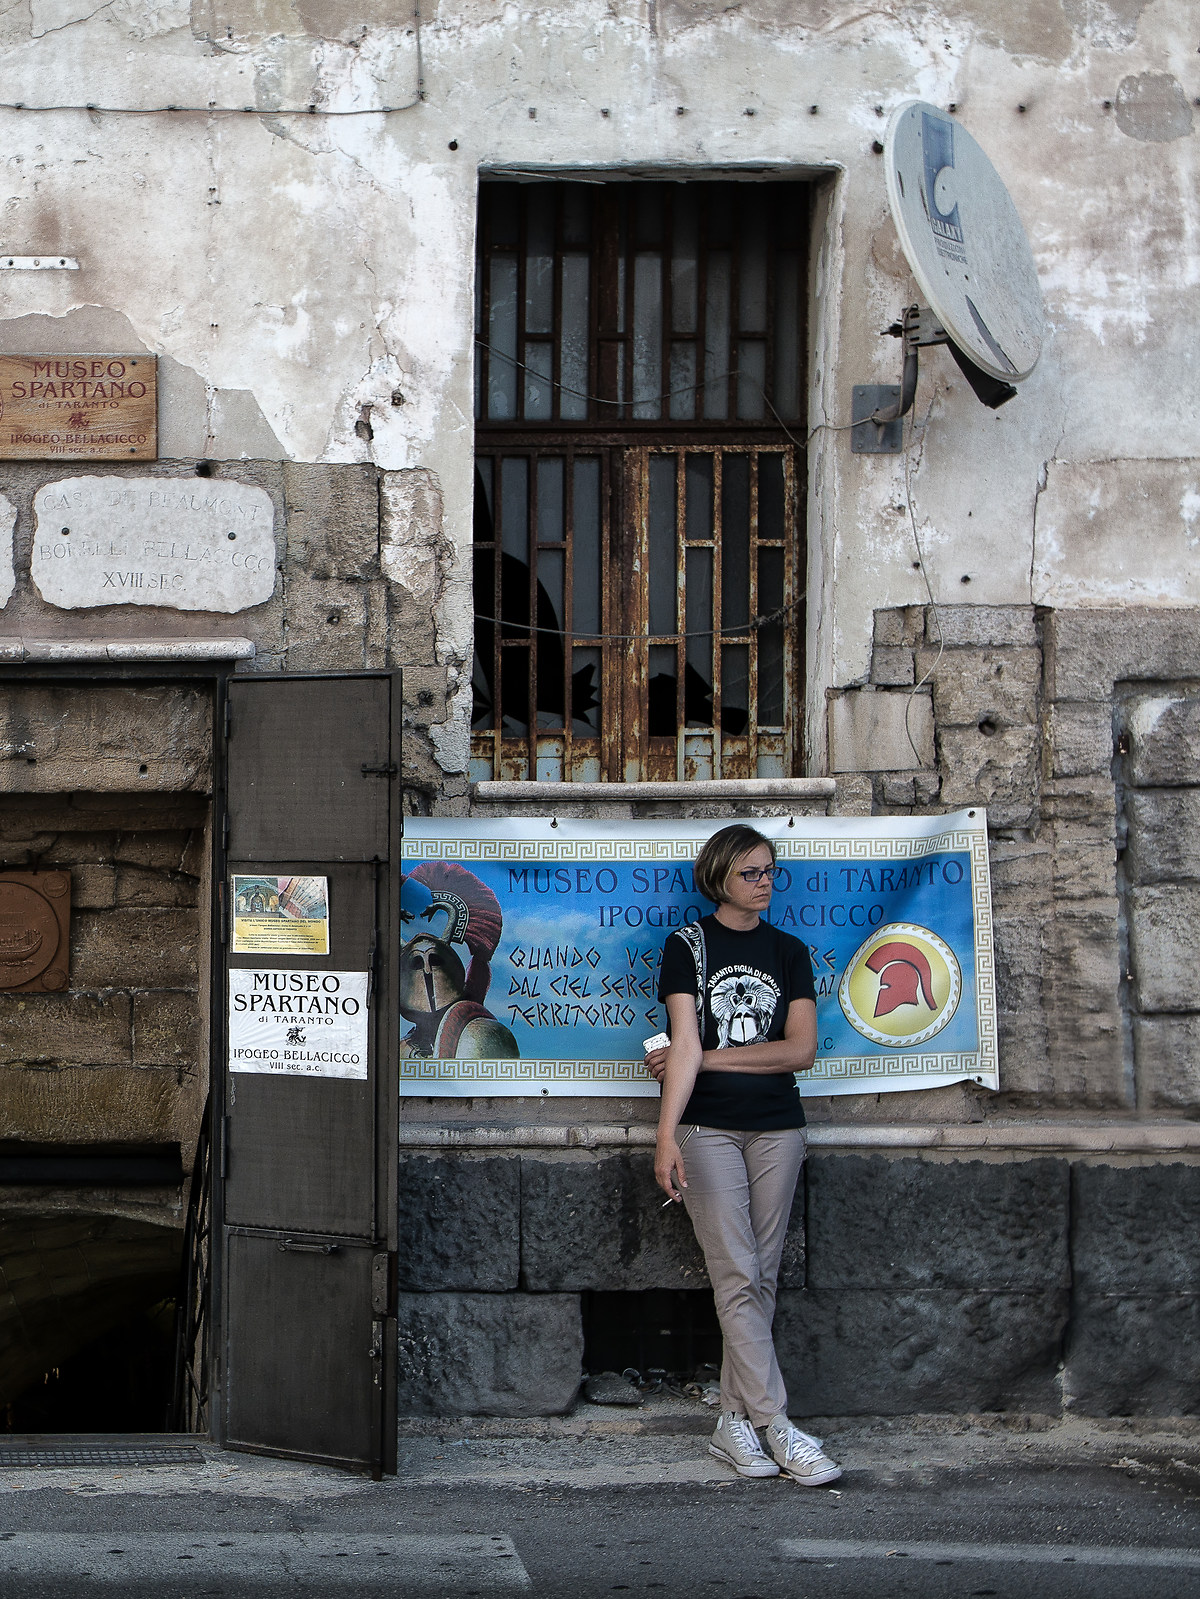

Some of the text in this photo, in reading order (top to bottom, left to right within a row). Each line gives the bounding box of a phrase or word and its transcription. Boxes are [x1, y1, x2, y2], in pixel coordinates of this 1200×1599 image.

[930, 217, 962, 241] GALAXY
[33, 360, 126, 379] MUSEO
[11, 381, 147, 399] SPARTANO
[38, 400, 120, 409] di TARANTO
[10, 434, 147, 444] IPOGEO BELLACICCO
[49, 446, 66, 454] VIII
[102, 571, 187, 591] XVIII SEC.
[508, 868, 618, 894] MUSEO
[806, 868, 829, 893] di
[839, 860, 964, 893] TARANTO
[599, 905, 702, 927] IPOGEO
[509, 946, 601, 970] QUANDO
[253, 973, 340, 993] MUSEO
[508, 976, 541, 998] DAL
[550, 975, 592, 999] CIEL
[708, 964, 781, 997] TARANTO FIGLIA DI SPARTA
[234, 993, 360, 1015] SPARTANO
[274, 1016, 334, 1025] TARANTO
[508, 1003, 658, 1028] TERRITORIO E
[234, 1049, 360, 1064] IPOGEO BELLACICCO
[269, 1062, 284, 1070] VIII
[287, 1063, 304, 1071] sec.
